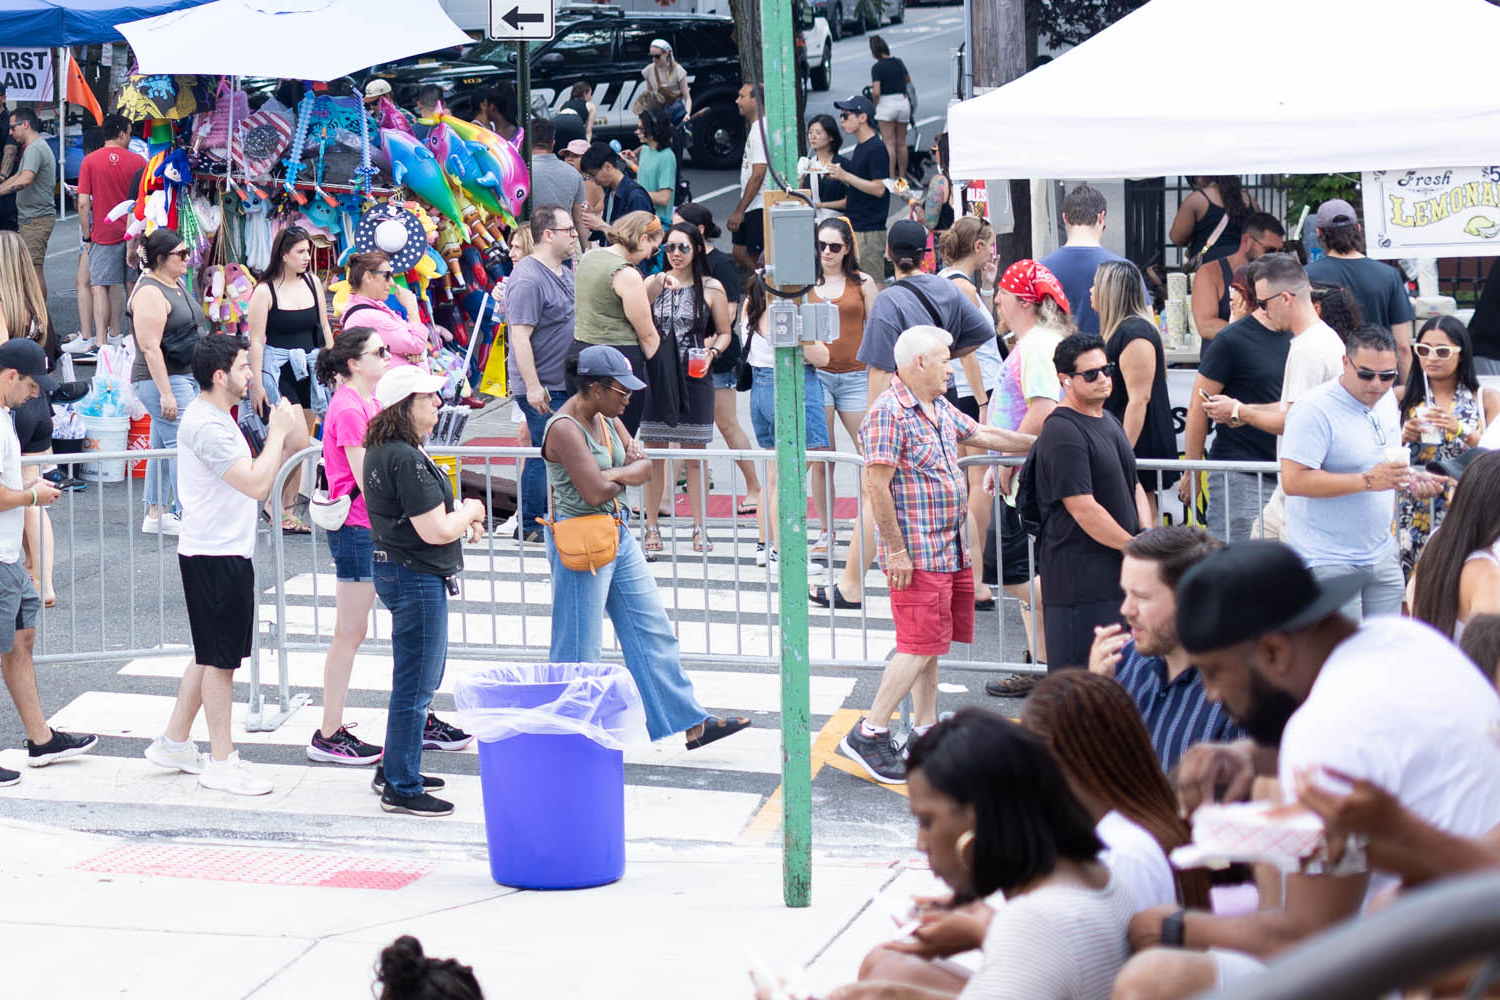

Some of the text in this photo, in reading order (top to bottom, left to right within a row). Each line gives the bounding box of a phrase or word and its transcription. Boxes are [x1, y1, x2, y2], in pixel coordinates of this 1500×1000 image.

[4, 72, 37, 90] AID
[1397, 169, 1453, 187] Fresh
[1389, 181, 1500, 228] LEMONA
